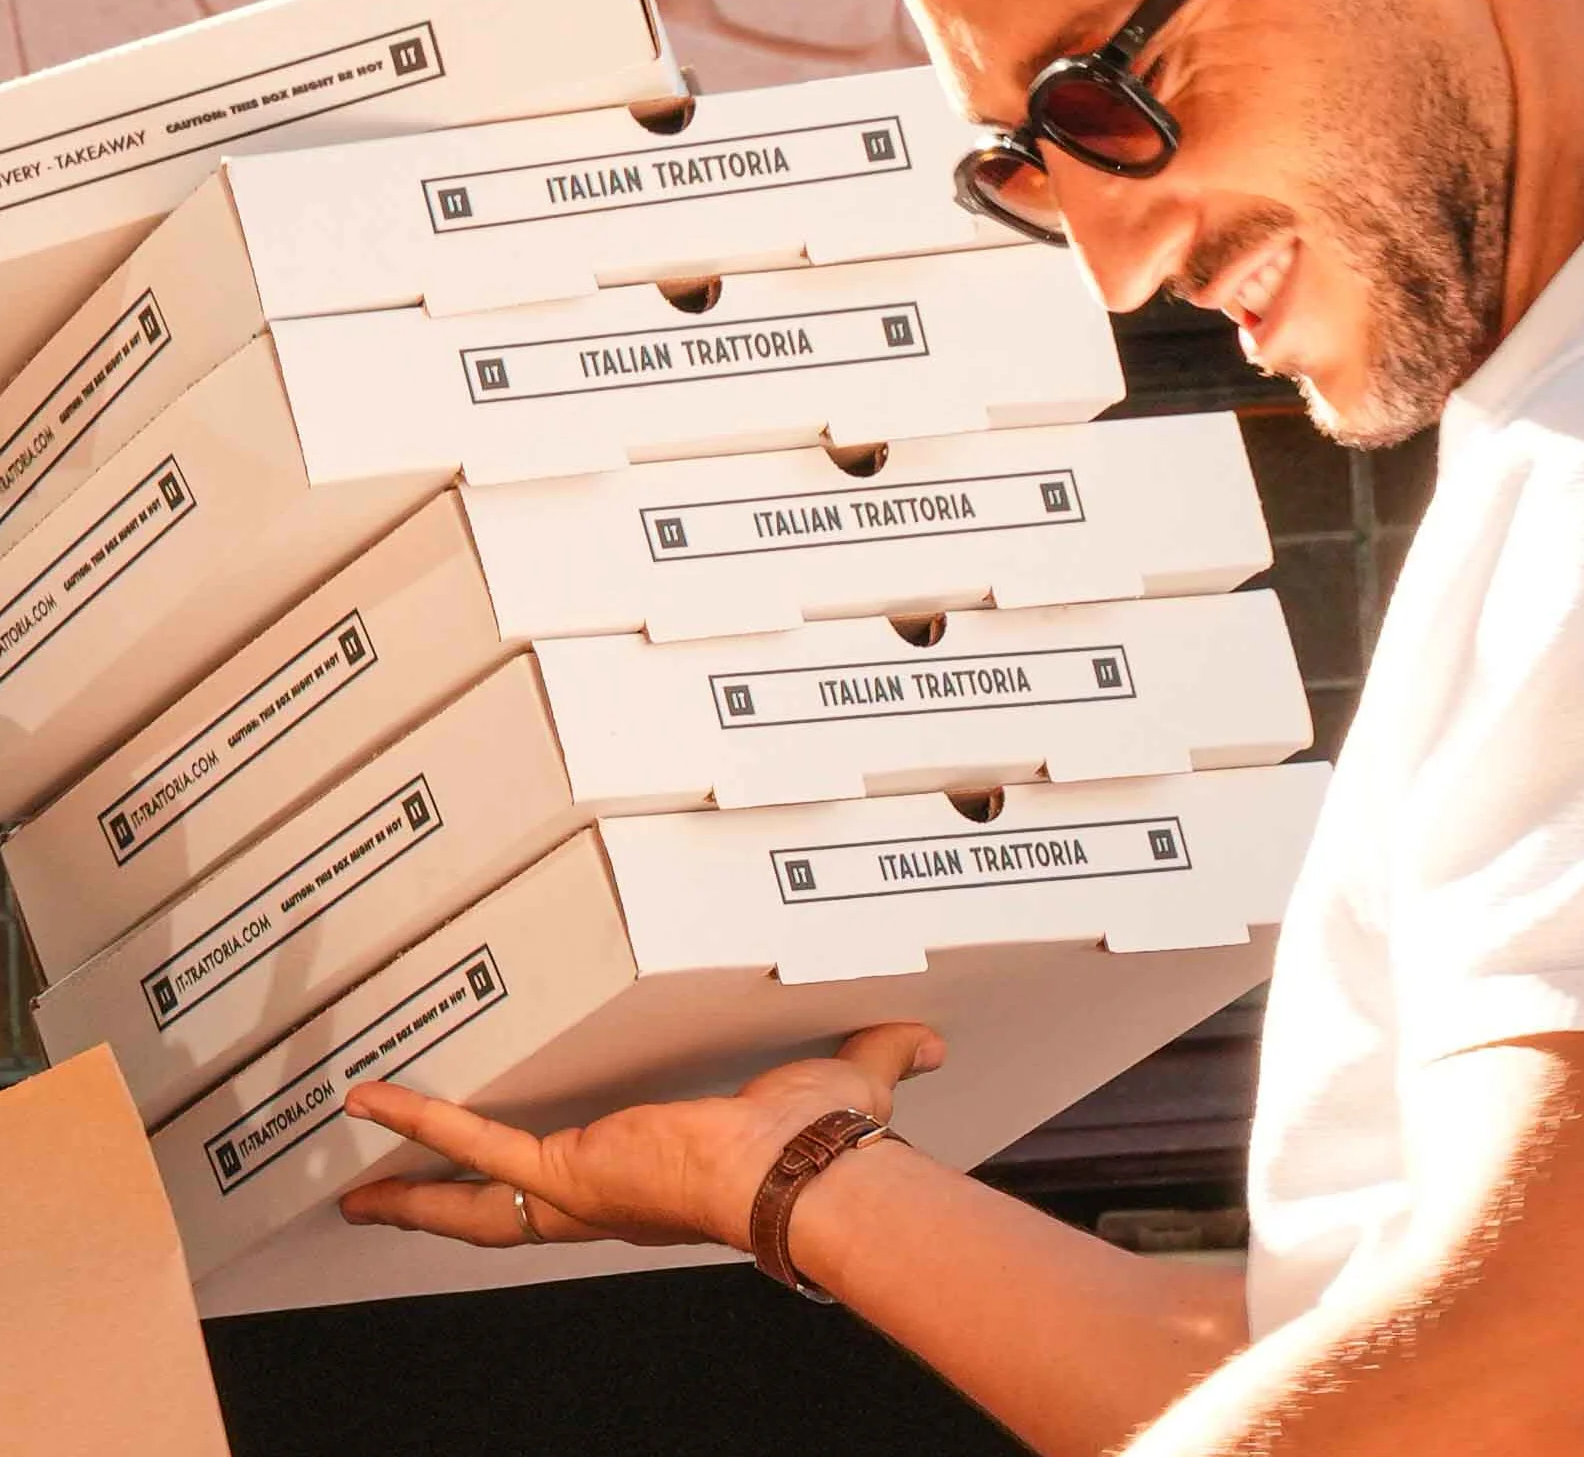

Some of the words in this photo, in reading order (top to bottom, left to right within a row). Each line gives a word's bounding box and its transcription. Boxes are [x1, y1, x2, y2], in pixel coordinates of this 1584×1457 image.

[55, 129, 145, 170] TAKEAWAY
[229, 98, 260, 115] THIS
[261, 89, 290, 106] BOX
[291, 75, 334, 97] MIGHT
[356, 60, 383, 77] HOT
[546, 166, 643, 204] ITALIAN
[651, 147, 790, 189] TRATTORIA
[579, 342, 673, 378] ITALIAN
[680, 328, 814, 367] TRATTORIA
[753, 505, 843, 538] ITALIAN
[849, 493, 976, 529] TRATTORIA
[818, 675, 905, 707] ITALIAN
[911, 666, 1032, 699] TRATTORIA
[129, 750, 219, 831] IT-TRATTORIA.COM
[877, 849, 964, 881] ITALIAN
[969, 839, 1089, 873] TRATTORIA
[174, 913, 272, 994] IT-TRATTORIA.COM
[237, 1079, 335, 1159] IT-TRATTORIA.COM
